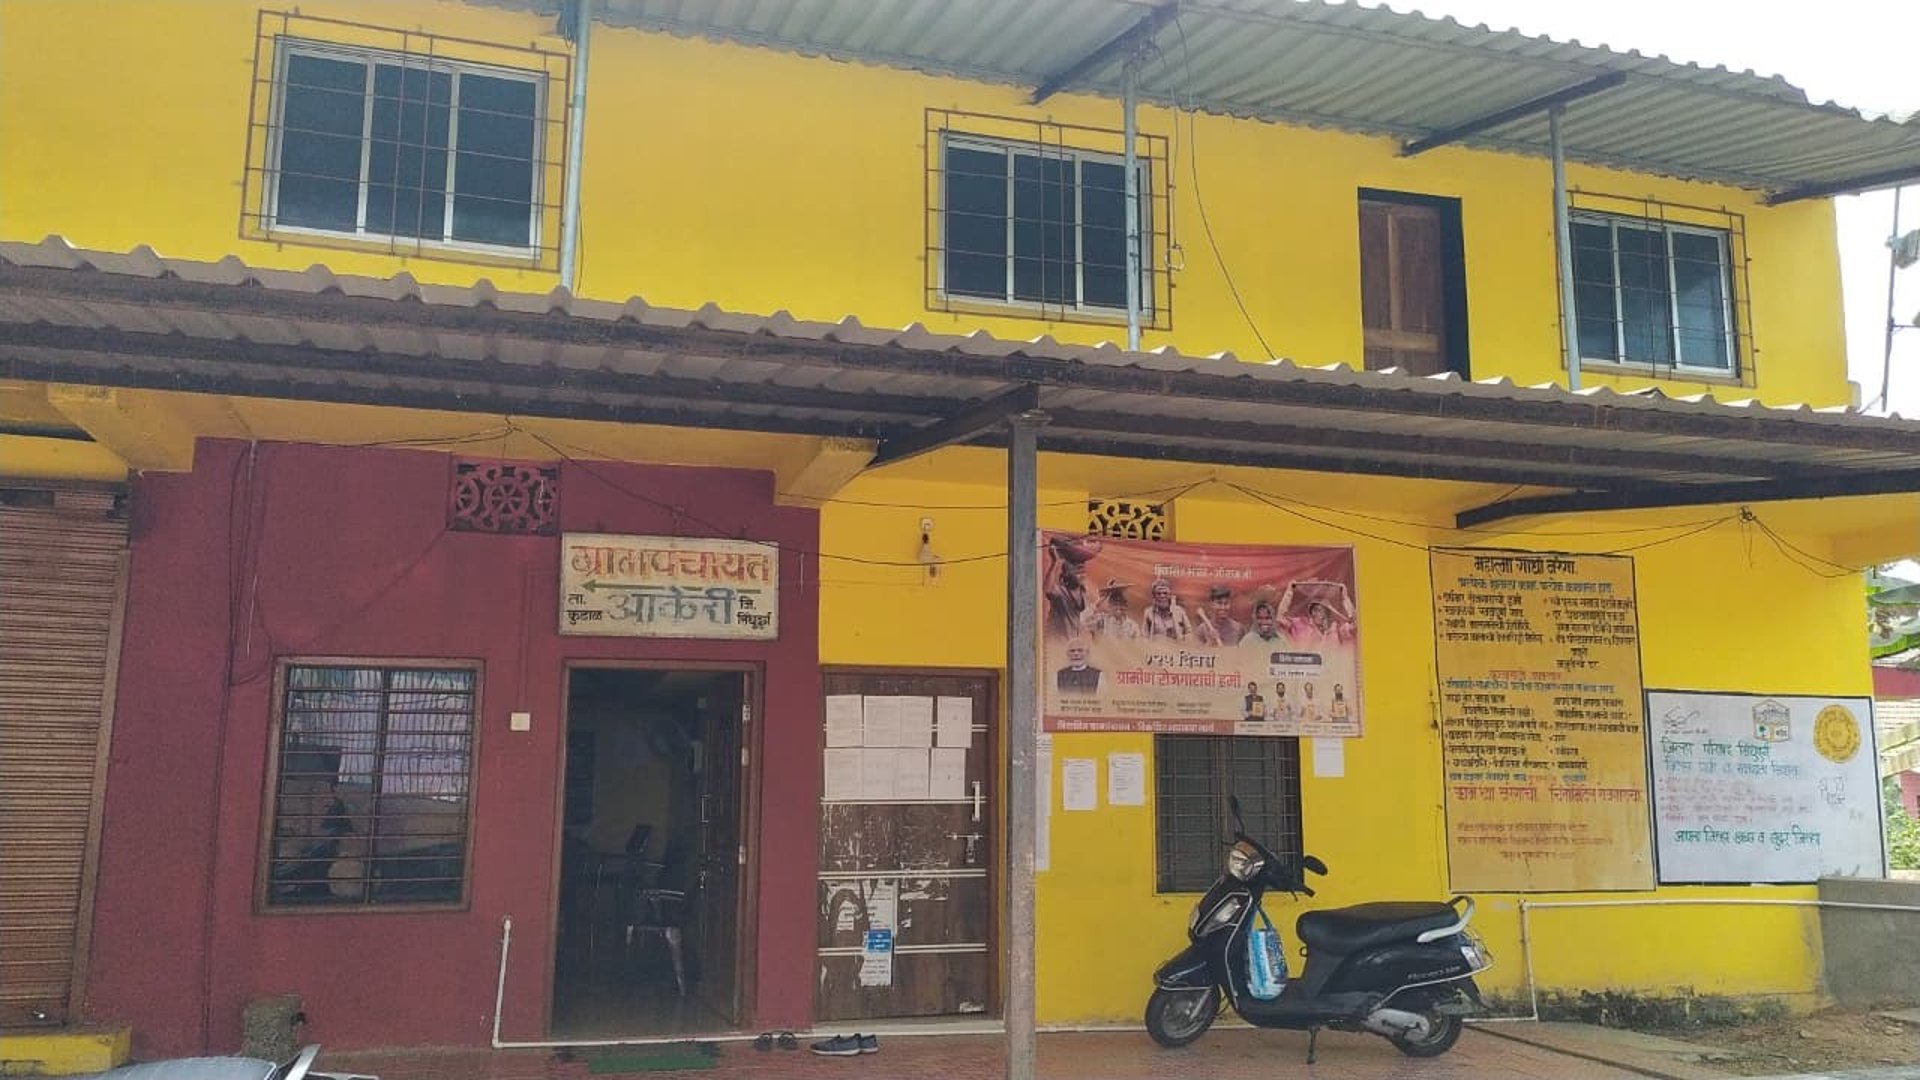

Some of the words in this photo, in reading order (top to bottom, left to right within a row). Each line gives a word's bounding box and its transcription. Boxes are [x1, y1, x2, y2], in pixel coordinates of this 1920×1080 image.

[568, 594, 587, 604] ता.
[738, 595, 757, 610] जि.
[566, 610, 602, 625] कुडाळ
[1115, 668, 1154, 686] ग्रामीण
[1156, 668, 1215, 687] रोजगाराची
